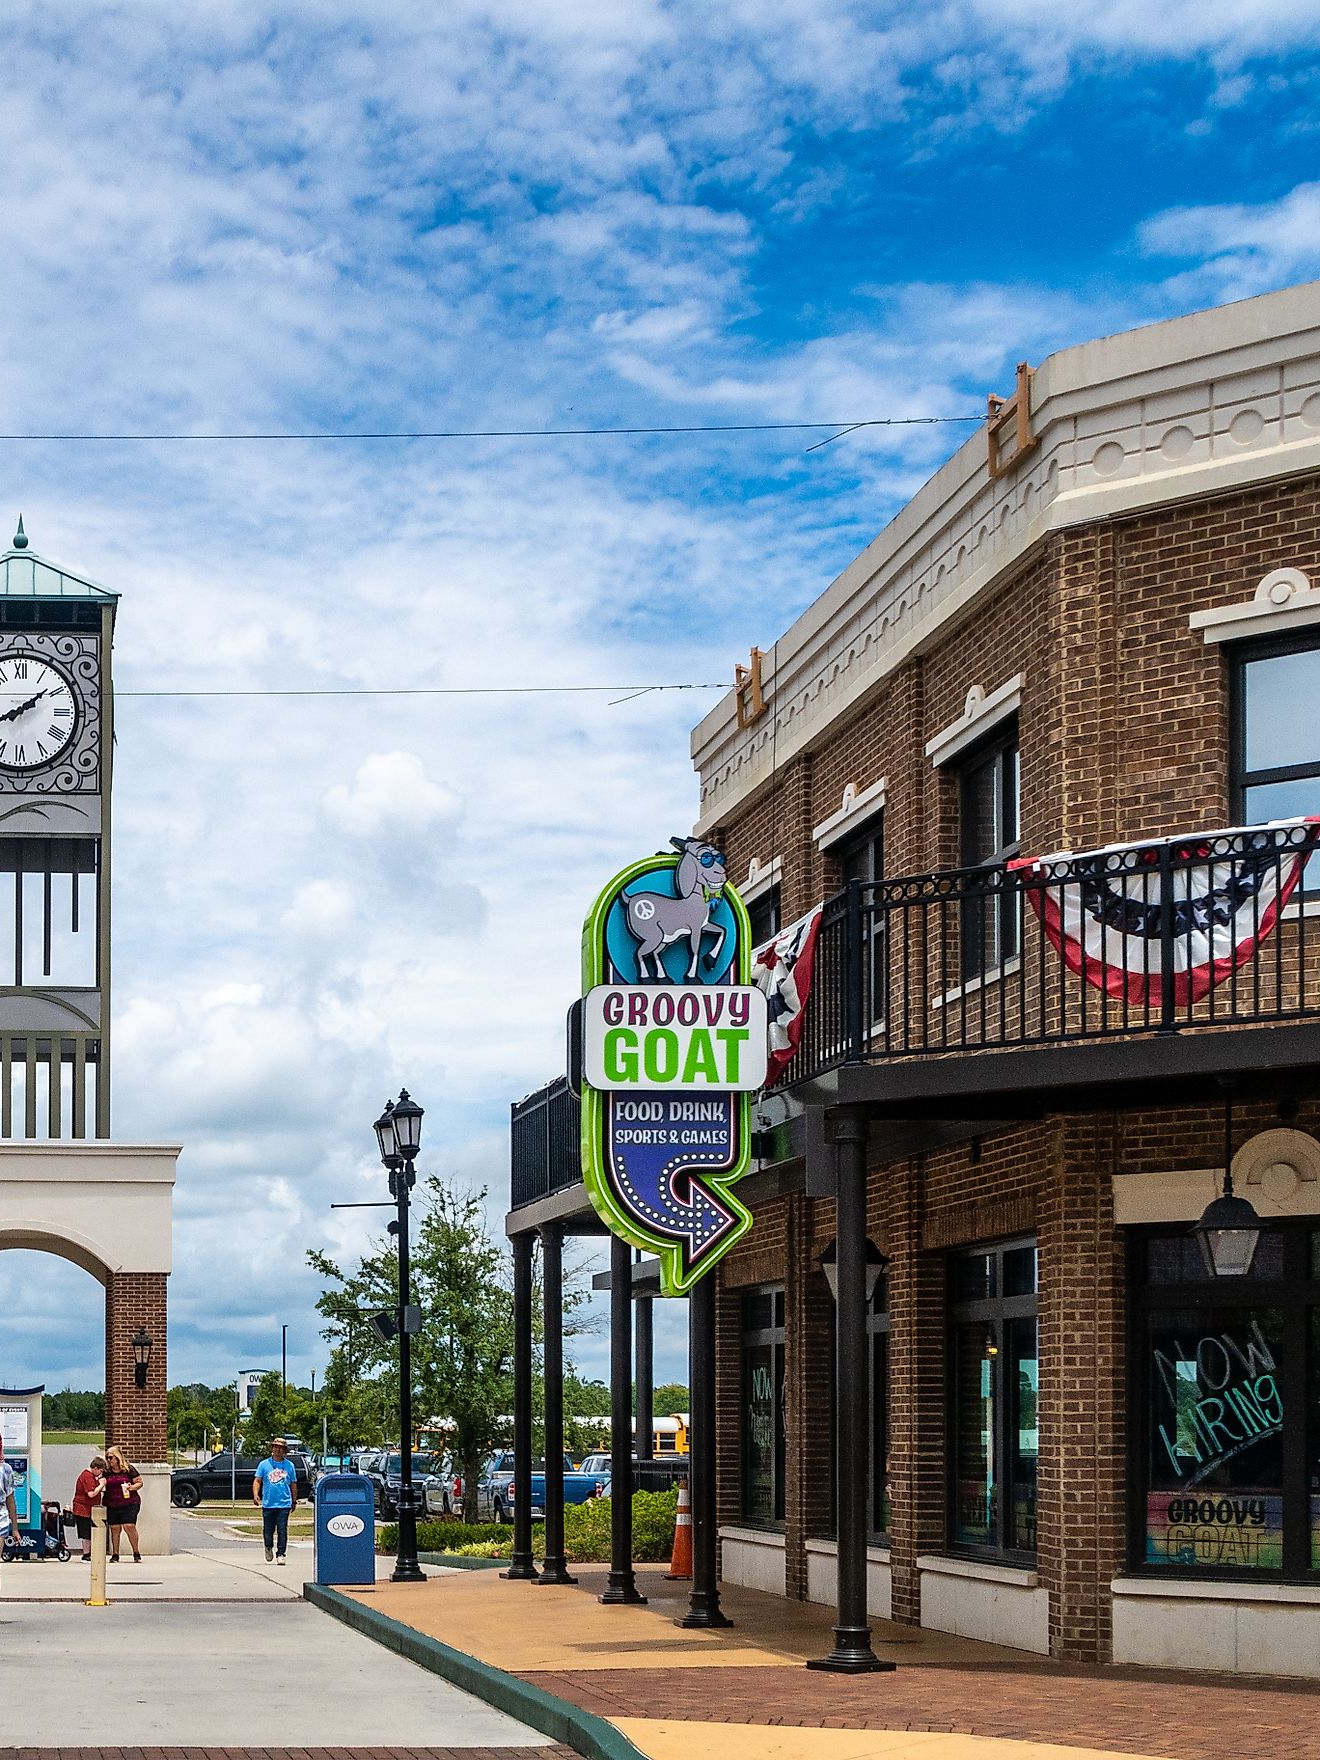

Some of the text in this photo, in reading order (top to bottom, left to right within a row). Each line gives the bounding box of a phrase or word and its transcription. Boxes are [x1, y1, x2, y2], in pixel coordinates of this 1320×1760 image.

[14, 663, 28, 679] XII
[49, 686, 65, 698] II
[53, 708, 71, 717] III
[15, 744, 26, 762] VI
[36, 740, 49, 758] V
[602, 991, 751, 1027] GROOVY
[603, 1027, 750, 1084] GOAT
[615, 1101, 728, 1124] FOOD, DRINK,
[615, 1129, 728, 1144] SPORTS & GAMES
[1153, 1314, 1277, 1409] NOW
[249, 1374, 261, 1383] OW
[1167, 1498, 1266, 1525] GROOVY
[332, 1521, 358, 1530] OWA
[1166, 1524, 1266, 1565] GOAT
